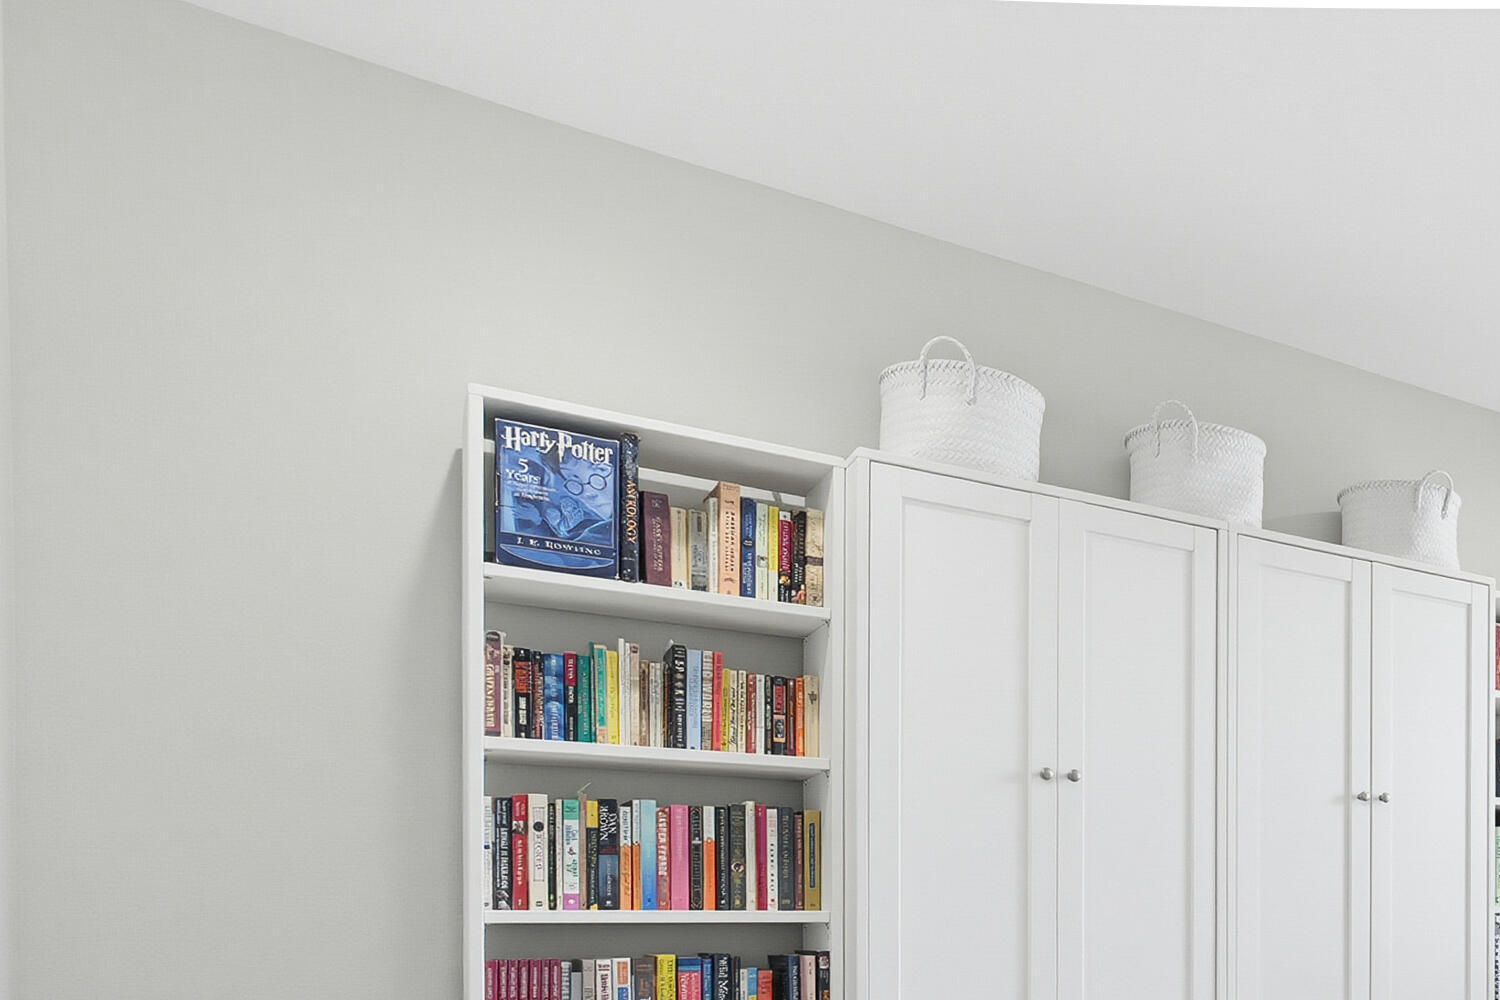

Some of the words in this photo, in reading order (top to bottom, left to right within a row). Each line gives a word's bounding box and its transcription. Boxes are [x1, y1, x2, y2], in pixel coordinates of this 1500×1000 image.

[501, 425, 556, 454] Harry
[556, 430, 614, 465] Potter
[517, 457, 529, 473] 5
[505, 468, 541, 484] Years
[625, 480, 638, 544] ASTROLOGY
[545, 540, 602, 556] ROWLING
[599, 806, 609, 841] BROWN
[608, 813, 618, 834] DAN
